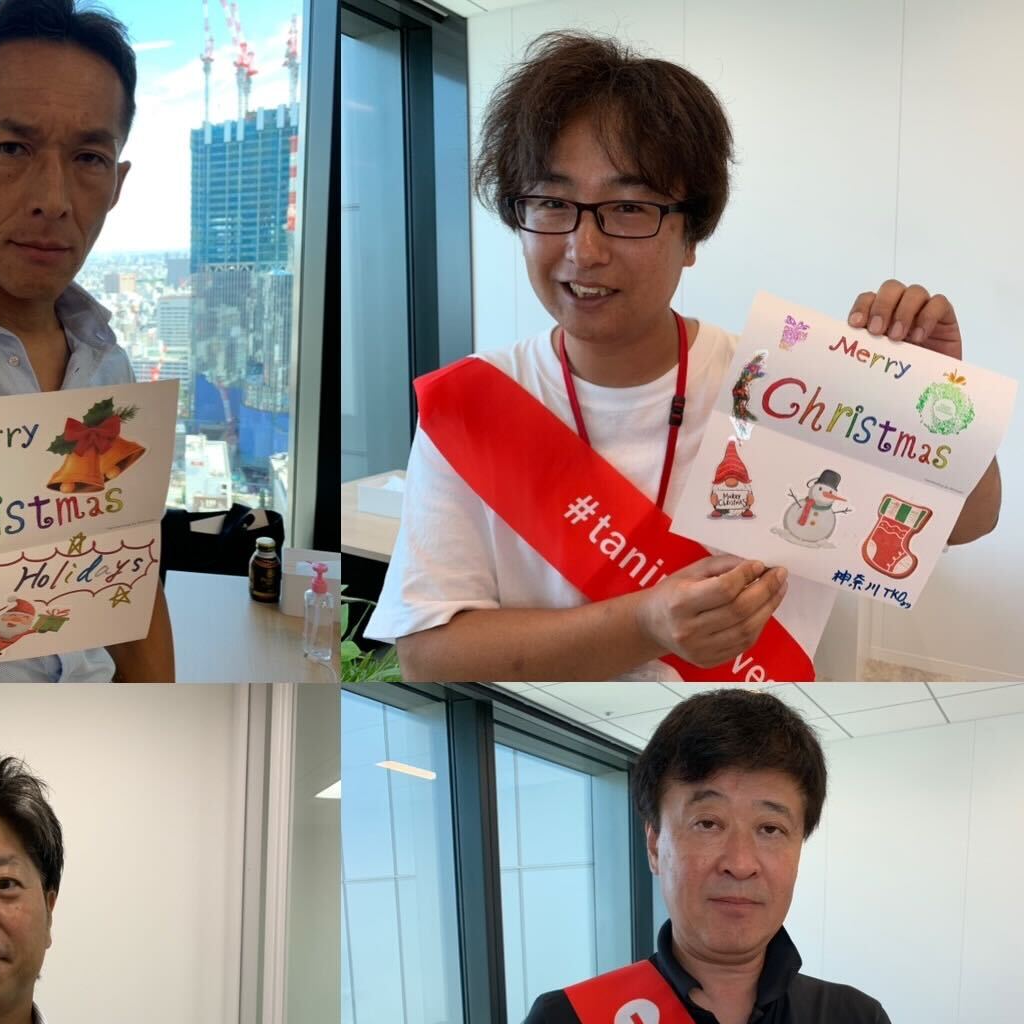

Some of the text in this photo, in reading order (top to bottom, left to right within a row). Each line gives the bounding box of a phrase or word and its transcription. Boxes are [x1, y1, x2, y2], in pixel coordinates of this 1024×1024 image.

[829, 335, 912, 379] Merry
[761, 377, 952, 470] Christmas
[14, 555, 144, 592] Holidays
[564, 495, 669, 587] #tani
